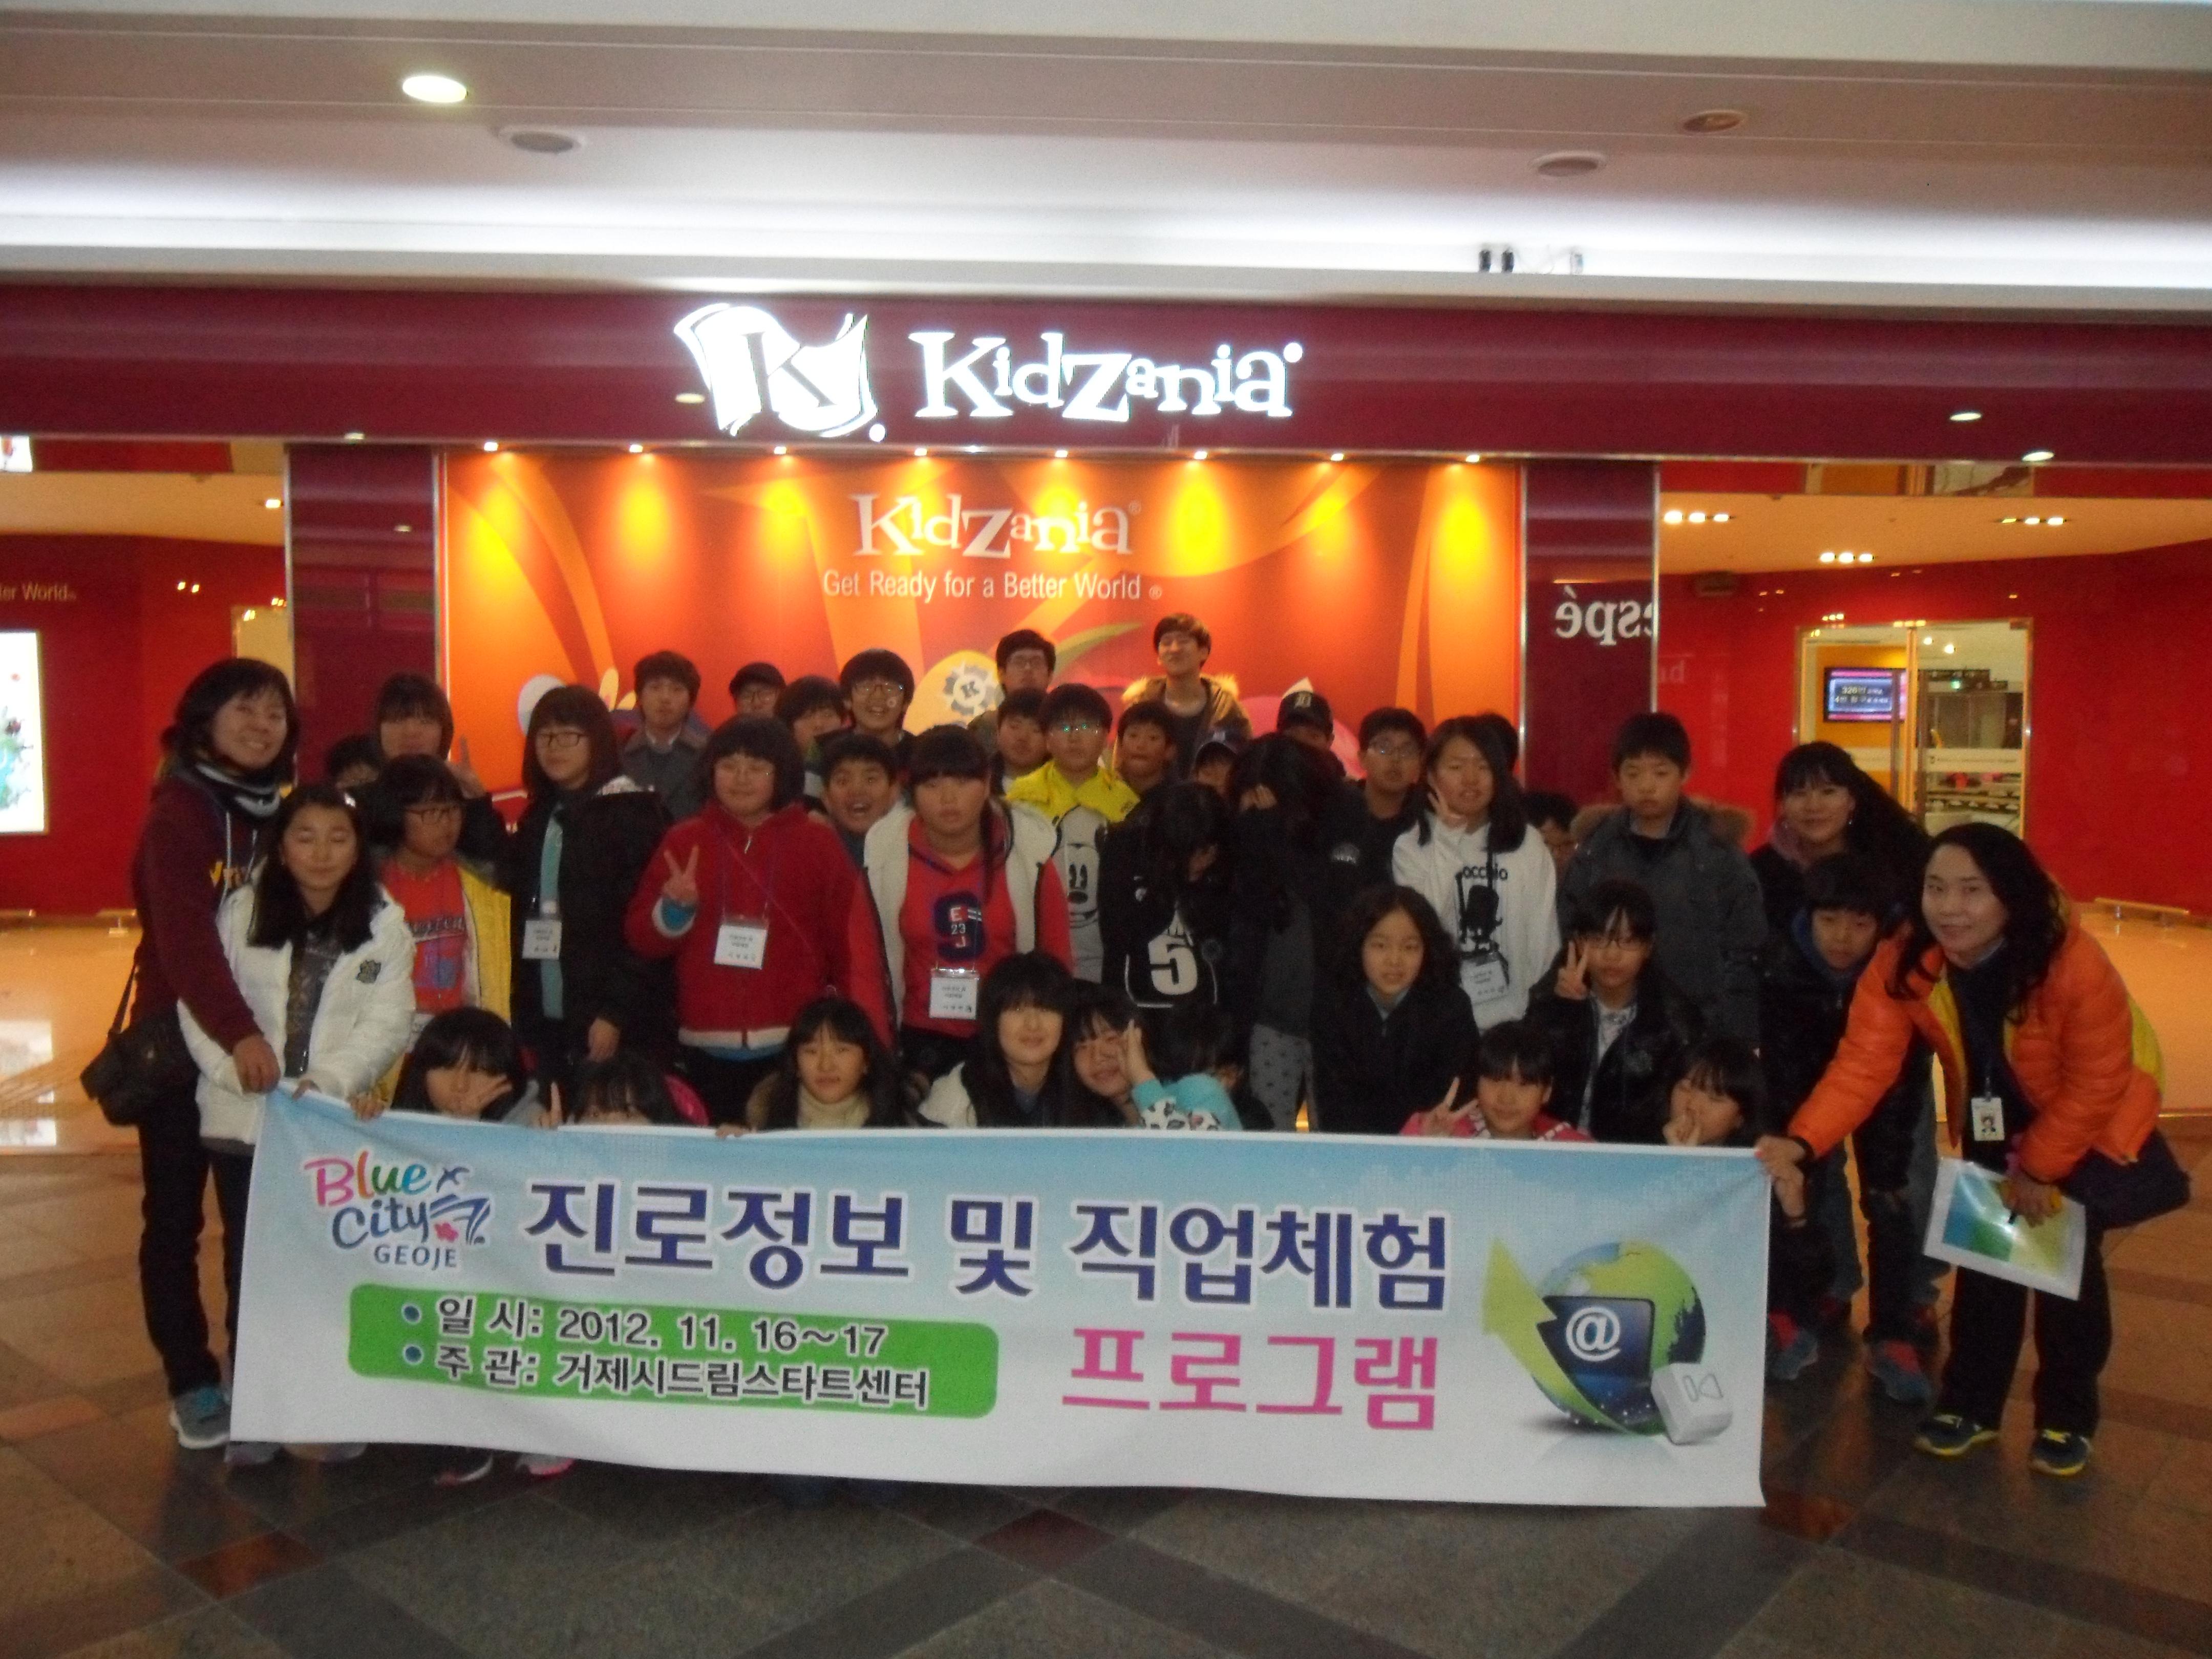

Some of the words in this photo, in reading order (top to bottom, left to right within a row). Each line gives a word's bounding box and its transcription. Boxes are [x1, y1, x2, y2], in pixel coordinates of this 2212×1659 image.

[908, 332, 1294, 422] KidZania
[22, 581, 68, 602] World
[823, 570, 860, 597] Get
[870, 570, 937, 603] Ready
[944, 570, 975, 598] for
[983, 577, 994, 599] a
[1004, 571, 1067, 600] Better
[1074, 572, 1141, 600] World
[950, 907, 963, 922] E
[951, 924, 966, 935] 23
[1147, 934, 1198, 995] 5
[304, 1150, 432, 1206] Blue
[332, 1197, 430, 1249] City
[524, 1183, 909, 1290] 진로정보
[950, 1200, 1033, 1296] 및
[1069, 1205, 1447, 1311] 직업체험
[373, 1244, 458, 1270] GEOJE
[558, 1354, 927, 1409] 거제시드림스타트센터
[1062, 1328, 1438, 1431] 프로그램
